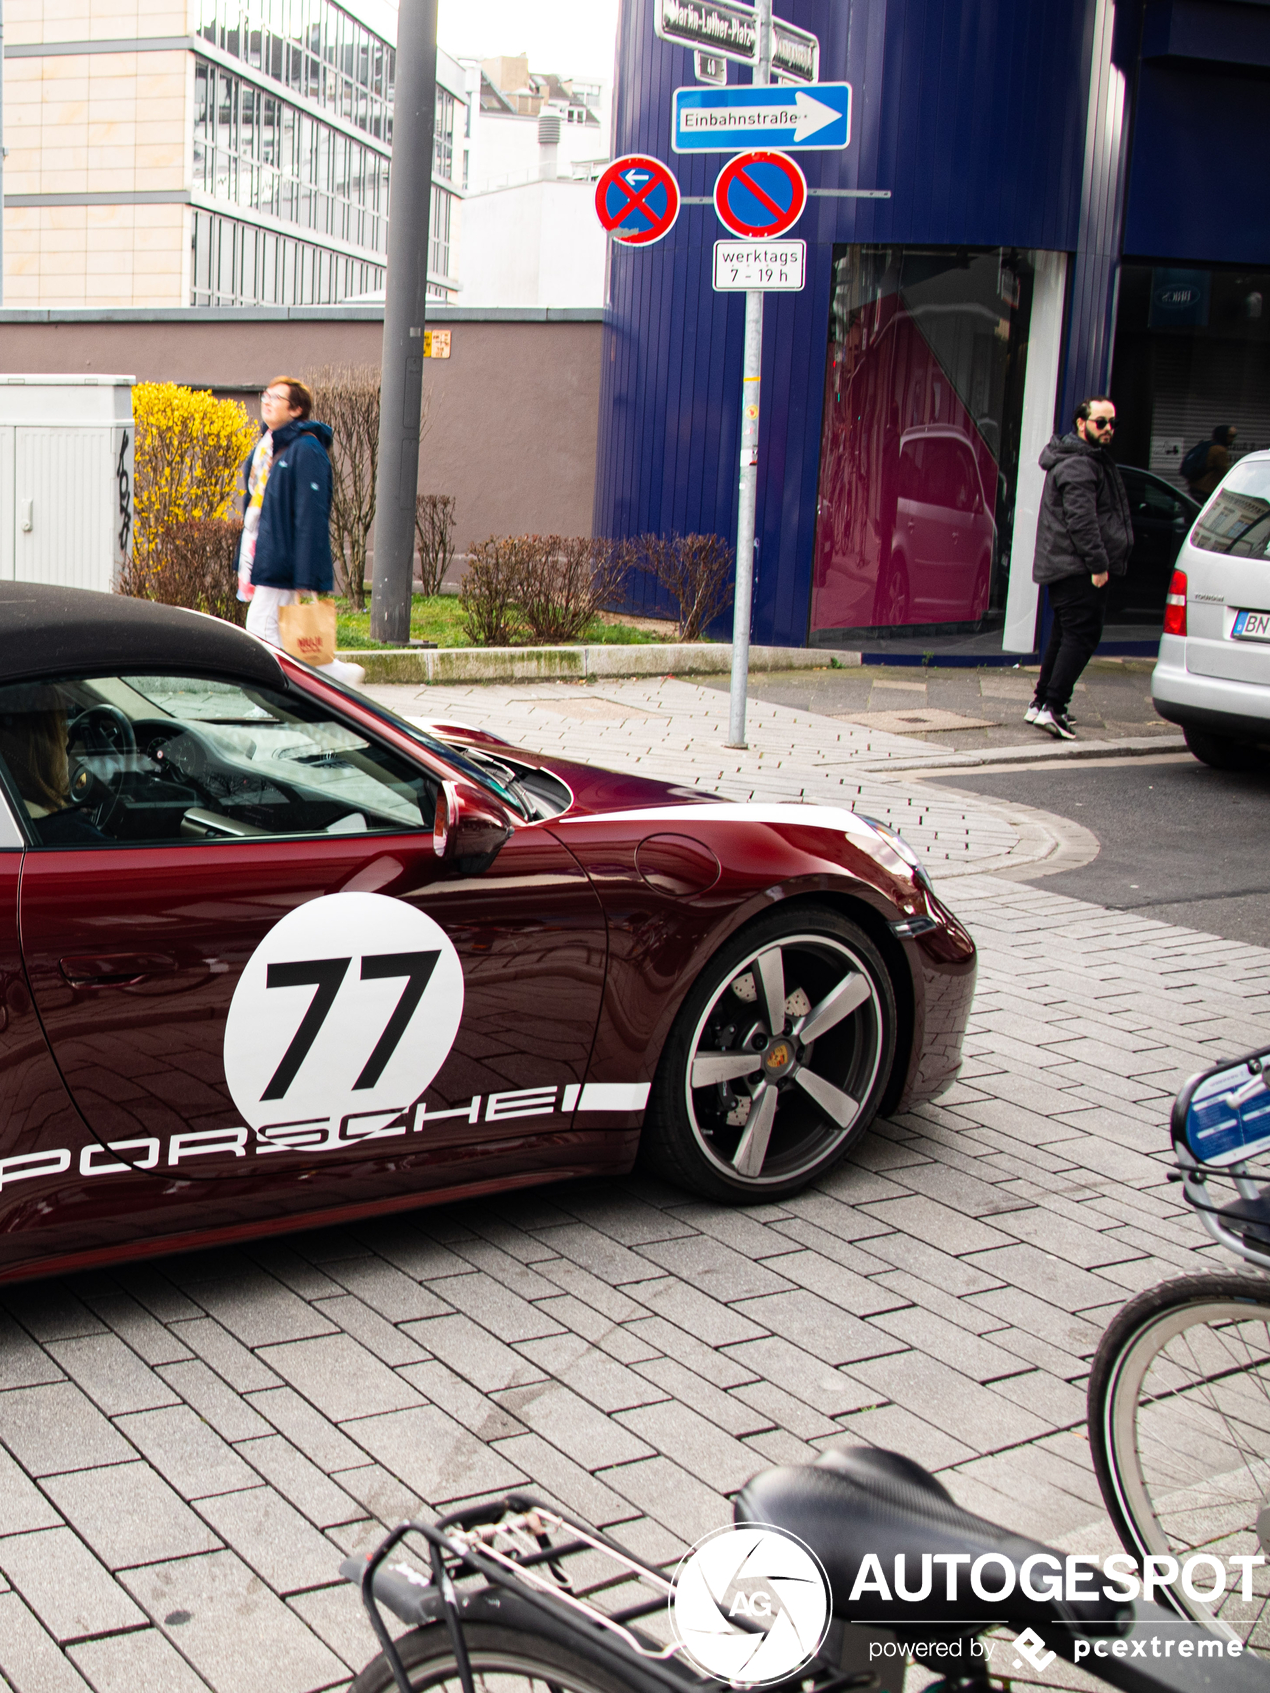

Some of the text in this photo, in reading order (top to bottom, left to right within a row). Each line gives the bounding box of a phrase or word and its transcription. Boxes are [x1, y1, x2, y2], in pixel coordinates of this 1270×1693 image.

[684, 111, 798, 127] Einbahnstraße
[722, 250, 798, 267] werktags
[730, 268, 739, 282] 7
[758, 268, 773, 282] 19
[779, 268, 788, 282] h
[1244, 615, 1270, 635] BN
[259, 949, 442, 1102] 77
